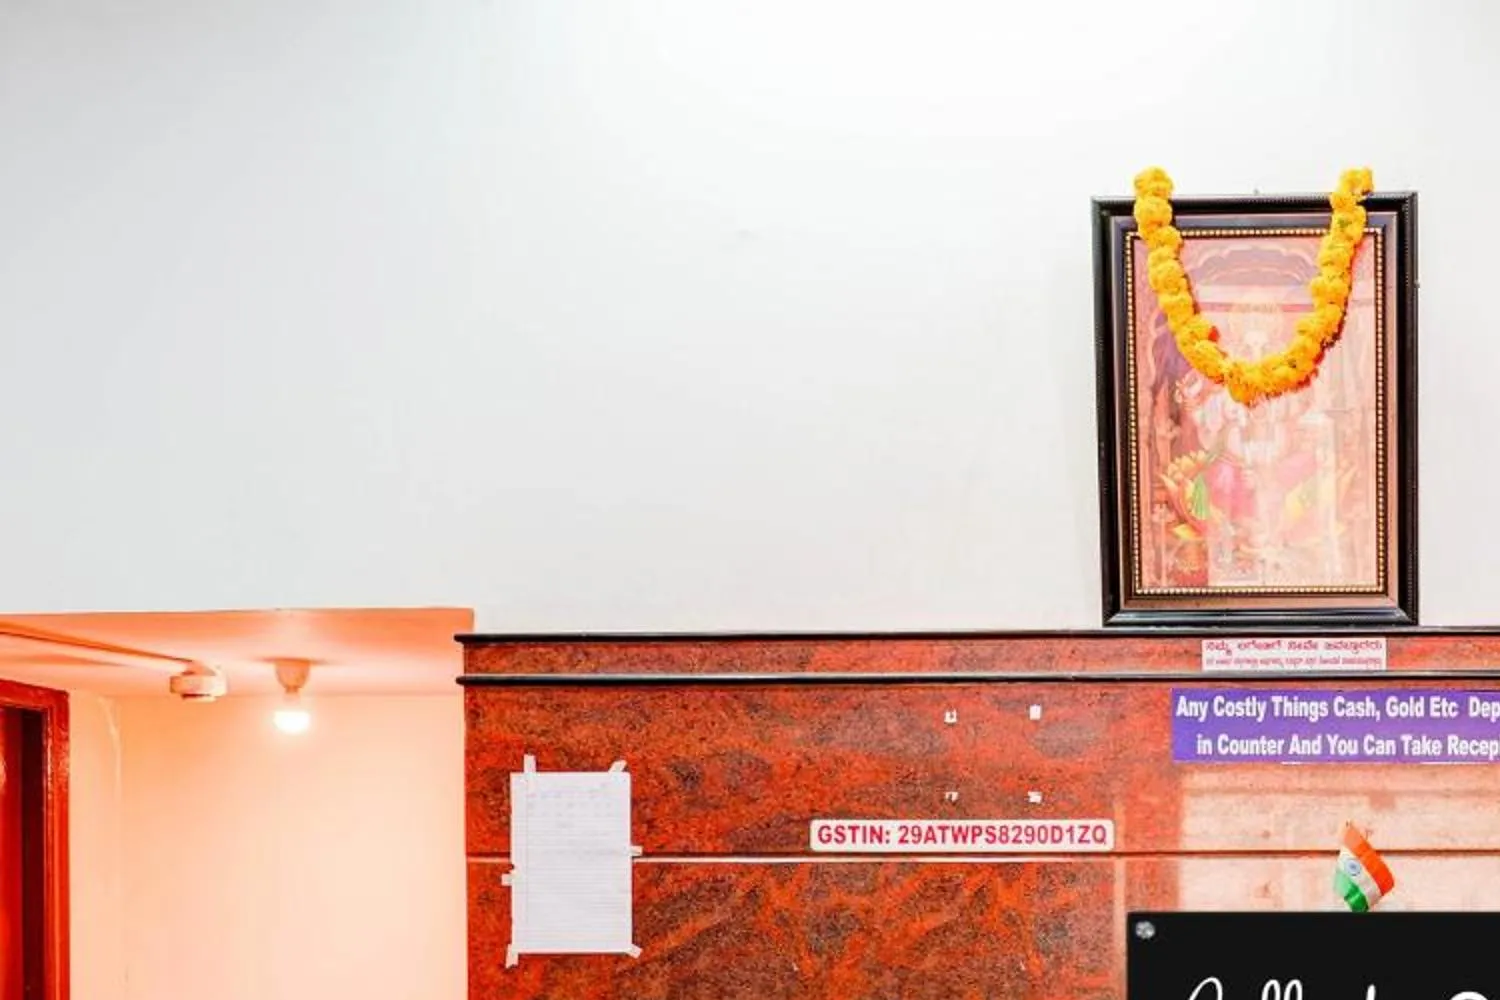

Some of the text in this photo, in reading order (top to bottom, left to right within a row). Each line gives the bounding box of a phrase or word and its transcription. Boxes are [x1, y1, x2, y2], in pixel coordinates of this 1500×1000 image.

[1175, 695, 1208, 722] Any
[1213, 695, 1266, 722] Costly
[1271, 695, 1329, 722] Things
[1332, 695, 1381, 721] Cash,
[1385, 695, 1424, 719] Gold
[1429, 696, 1458, 719] Etc
[1196, 734, 1213, 755] in
[1217, 734, 1285, 755] Counter
[1288, 734, 1323, 755] And
[1326, 734, 1359, 755] You
[1363, 734, 1397, 756] Can
[1400, 734, 1442, 756] Take
[816, 824, 892, 845] GSTIN:
